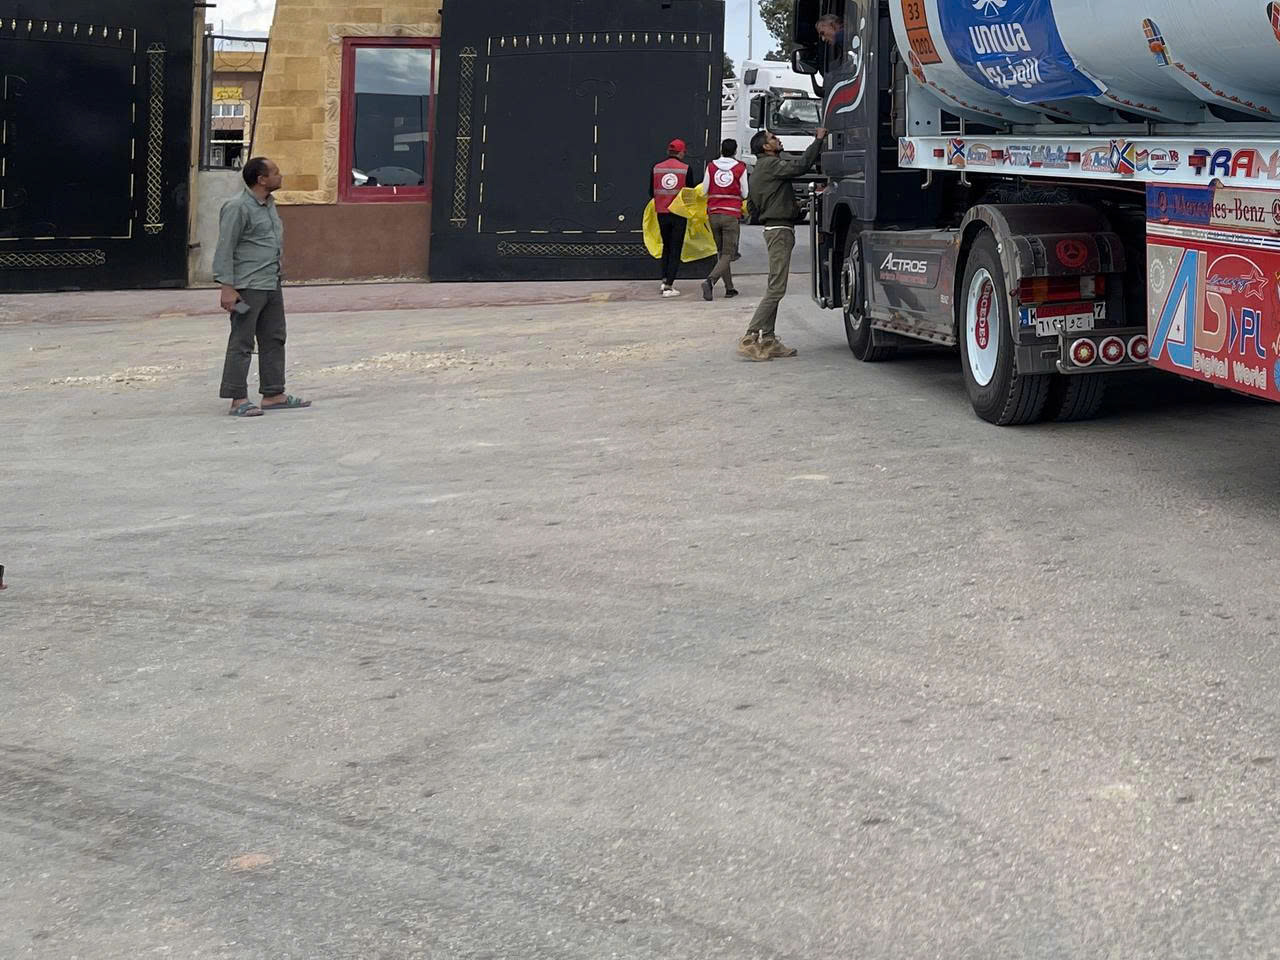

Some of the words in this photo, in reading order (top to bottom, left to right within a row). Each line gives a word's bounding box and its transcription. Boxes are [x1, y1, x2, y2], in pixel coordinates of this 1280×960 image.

[907, 1, 920, 21] 33
[968, 22, 1032, 54] unrwa
[880, 252, 928, 273] ACTROS
